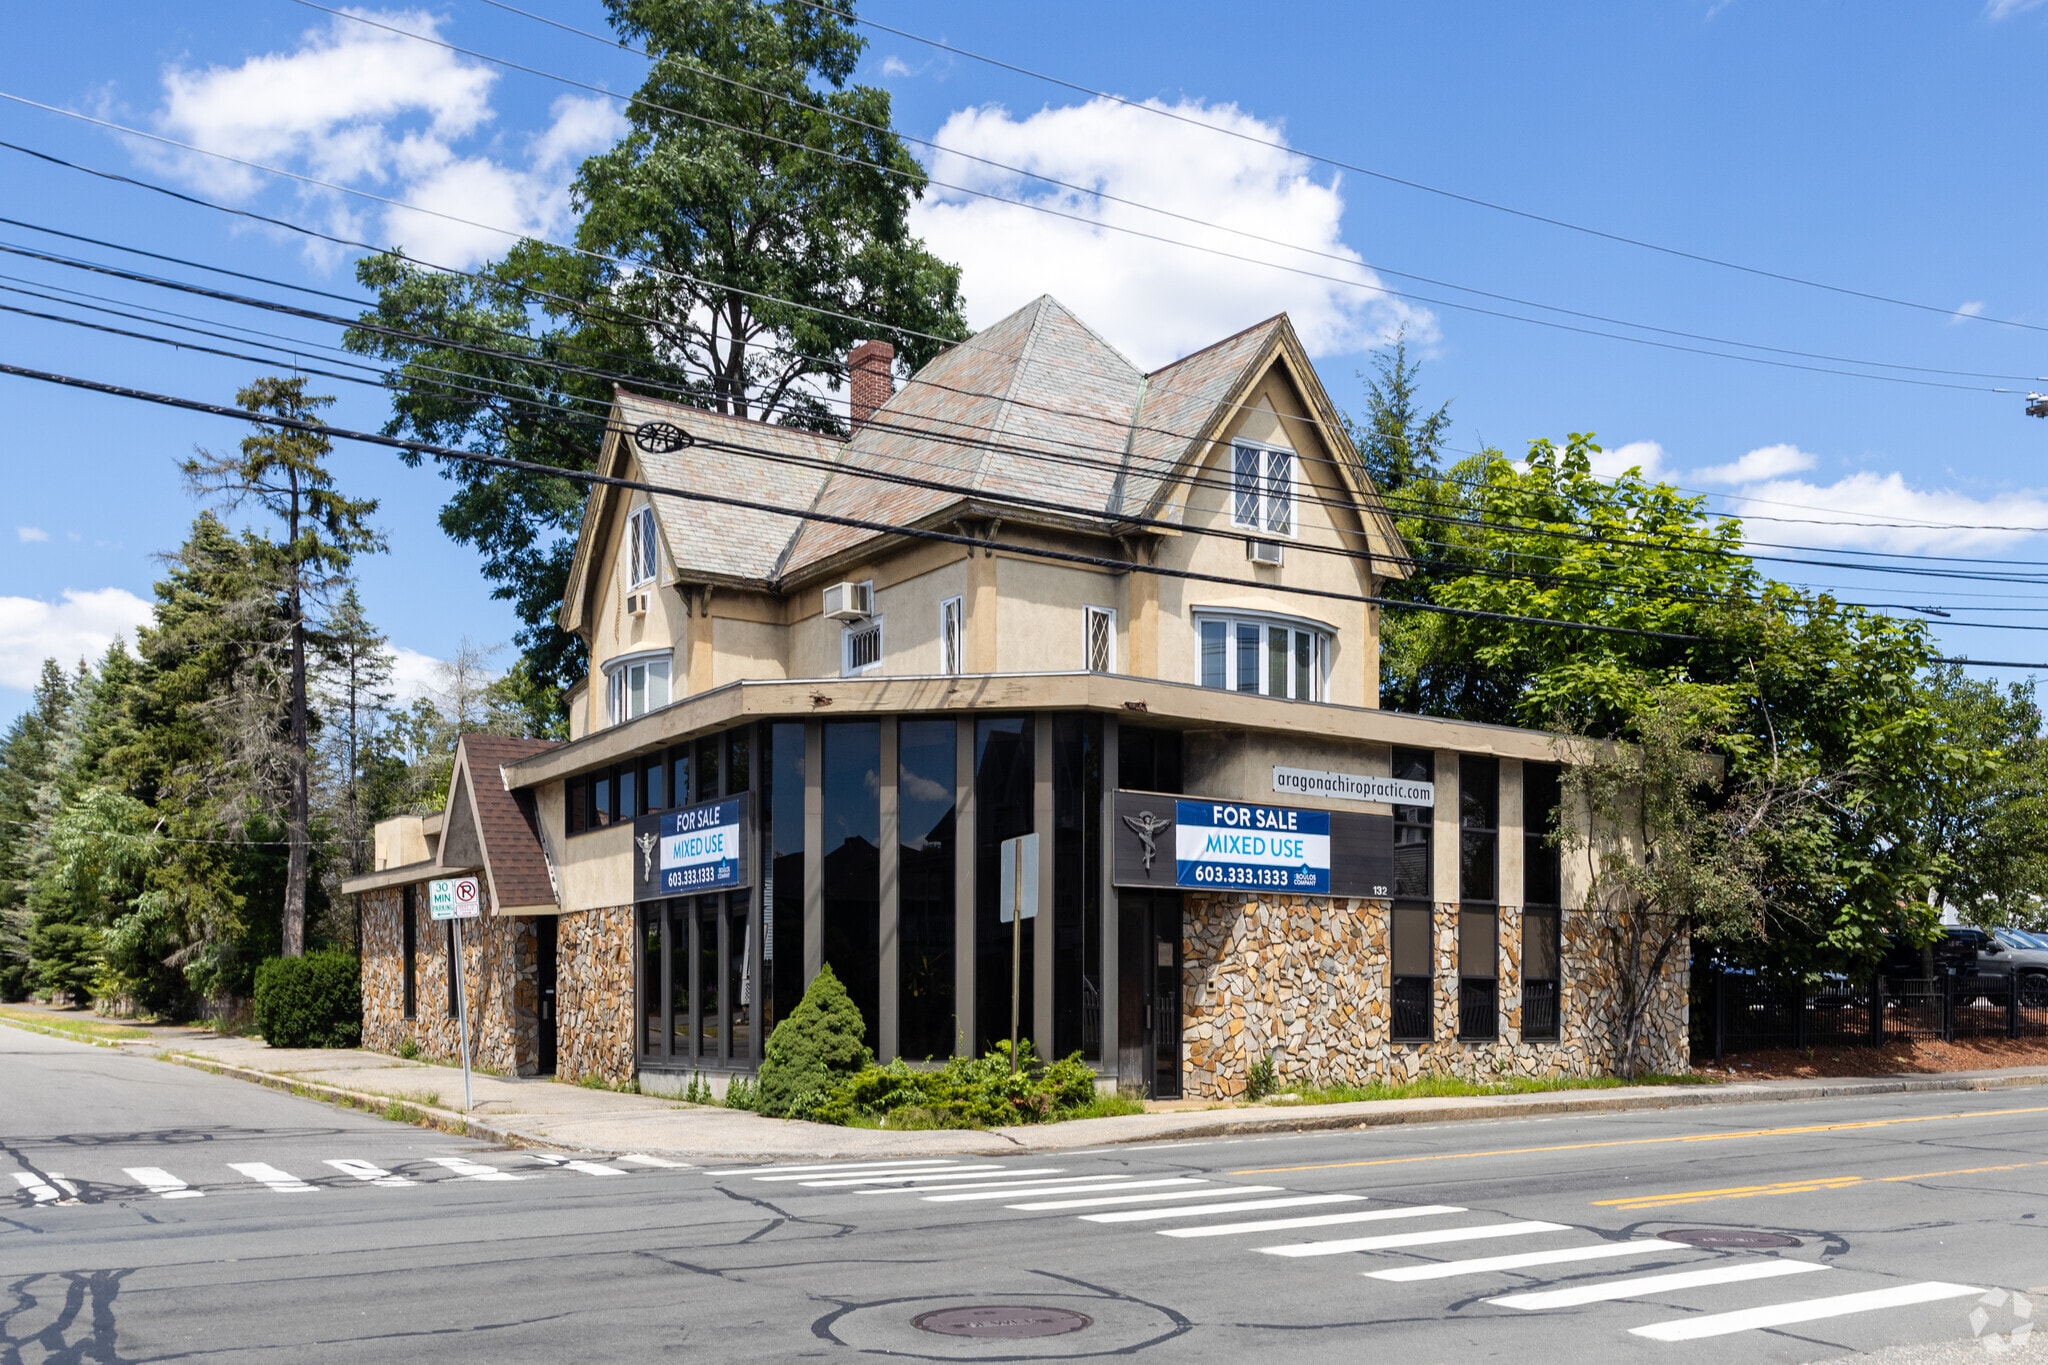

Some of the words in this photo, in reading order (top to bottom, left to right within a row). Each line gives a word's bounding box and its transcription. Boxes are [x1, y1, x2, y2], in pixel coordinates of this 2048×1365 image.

[1278, 773, 1430, 801] aragonachiropractic.com
[677, 814, 695, 832] FOR
[697, 806, 720, 828] SALE
[1213, 805, 1251, 827] FOR
[1256, 808, 1298, 831] SALE
[674, 838, 702, 859] MIXED
[704, 834, 723, 854] USE
[1206, 834, 1265, 856] MIXED
[1271, 838, 1304, 859] USE
[436, 883, 448, 892] 30
[668, 867, 714, 887] 603.333.1333
[1195, 865, 1288, 887] 603.333.1333
[434, 894, 450, 903] MIN
[1373, 885, 1388, 895] 132
